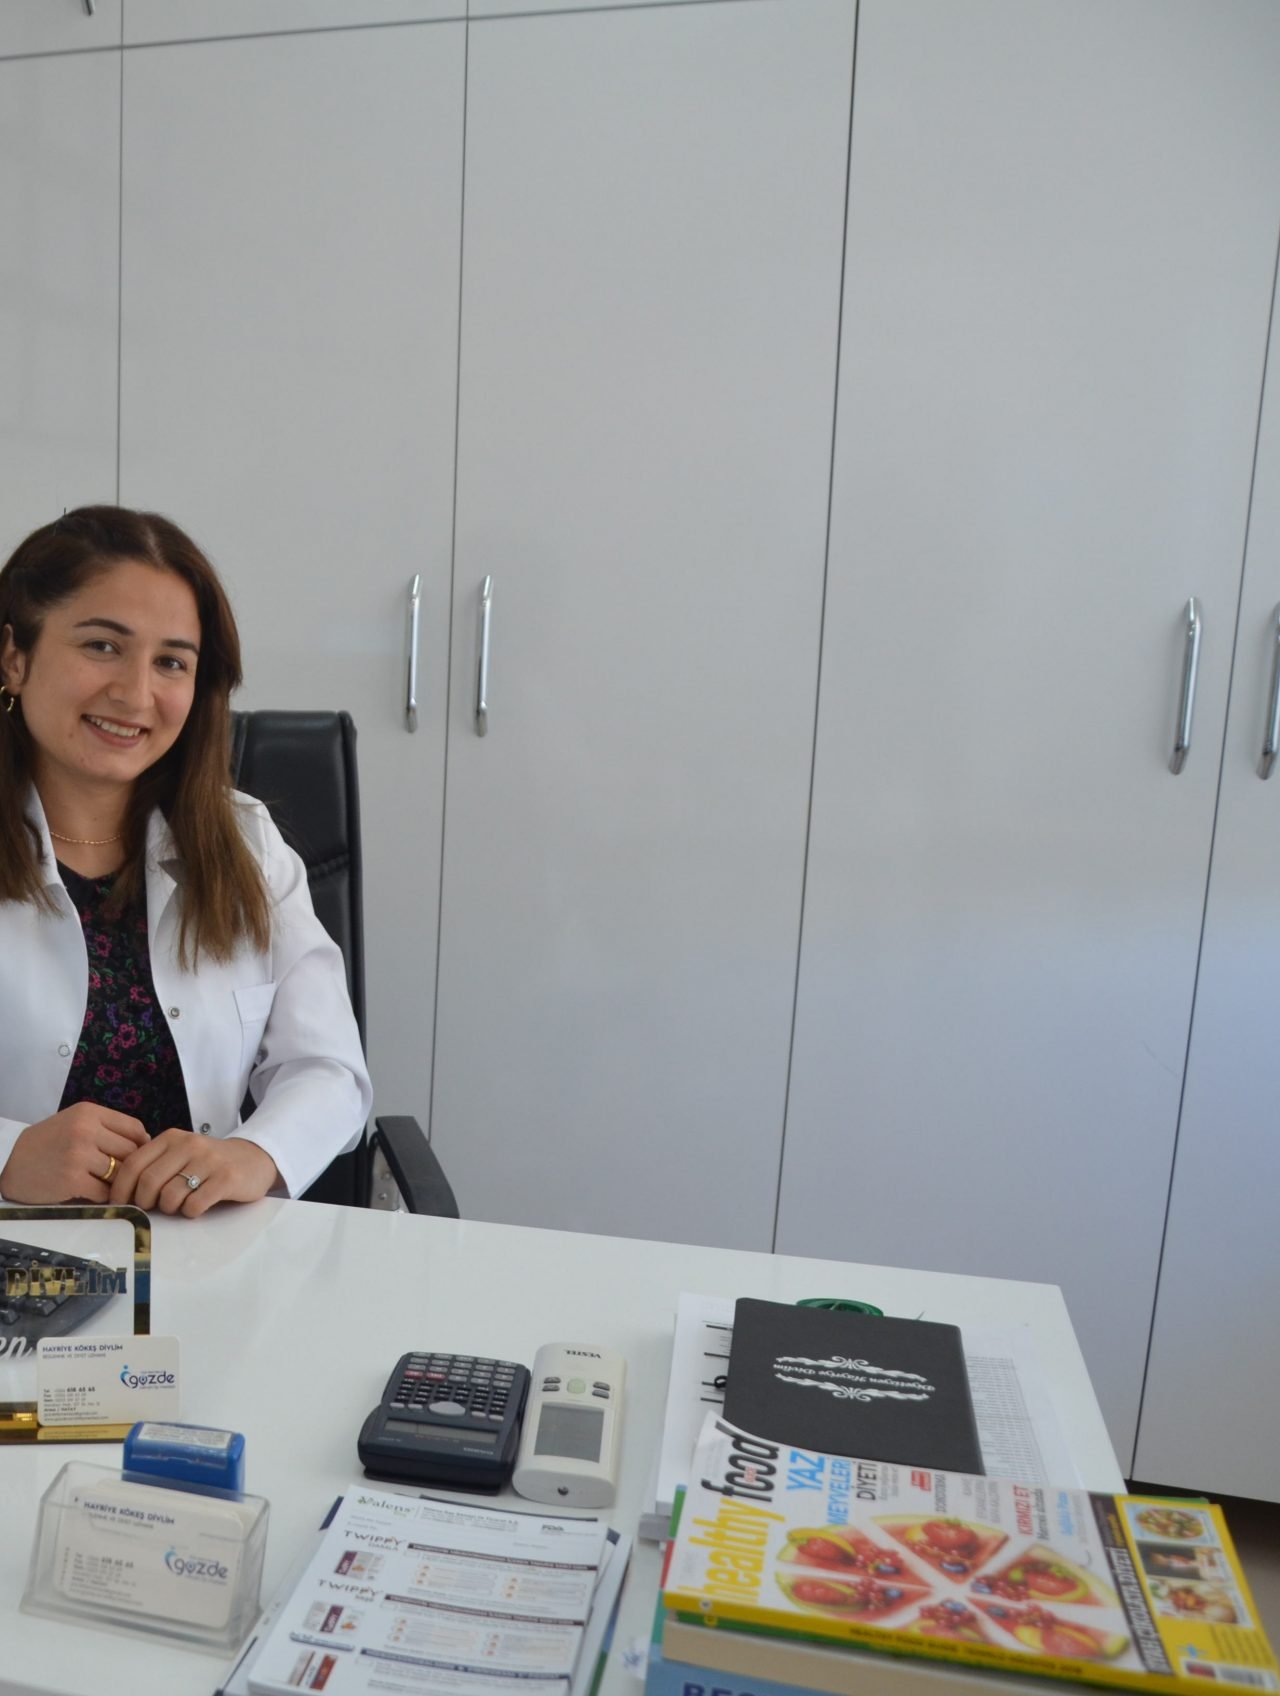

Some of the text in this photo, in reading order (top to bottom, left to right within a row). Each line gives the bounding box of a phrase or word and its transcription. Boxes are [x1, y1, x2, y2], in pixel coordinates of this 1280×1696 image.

[42, 1345, 72, 1353] HAYRİYE
[74, 1344, 97, 1353] KÖKEŞ
[563, 1349, 602, 1360] VESTEL
[700, 1420, 781, 1502] food
[785, 1450, 825, 1491] YAZ
[852, 1460, 877, 1502] DİYETİ
[826, 1457, 851, 1525] MEYVELERİ
[677, 1497, 786, 1605] healthy
